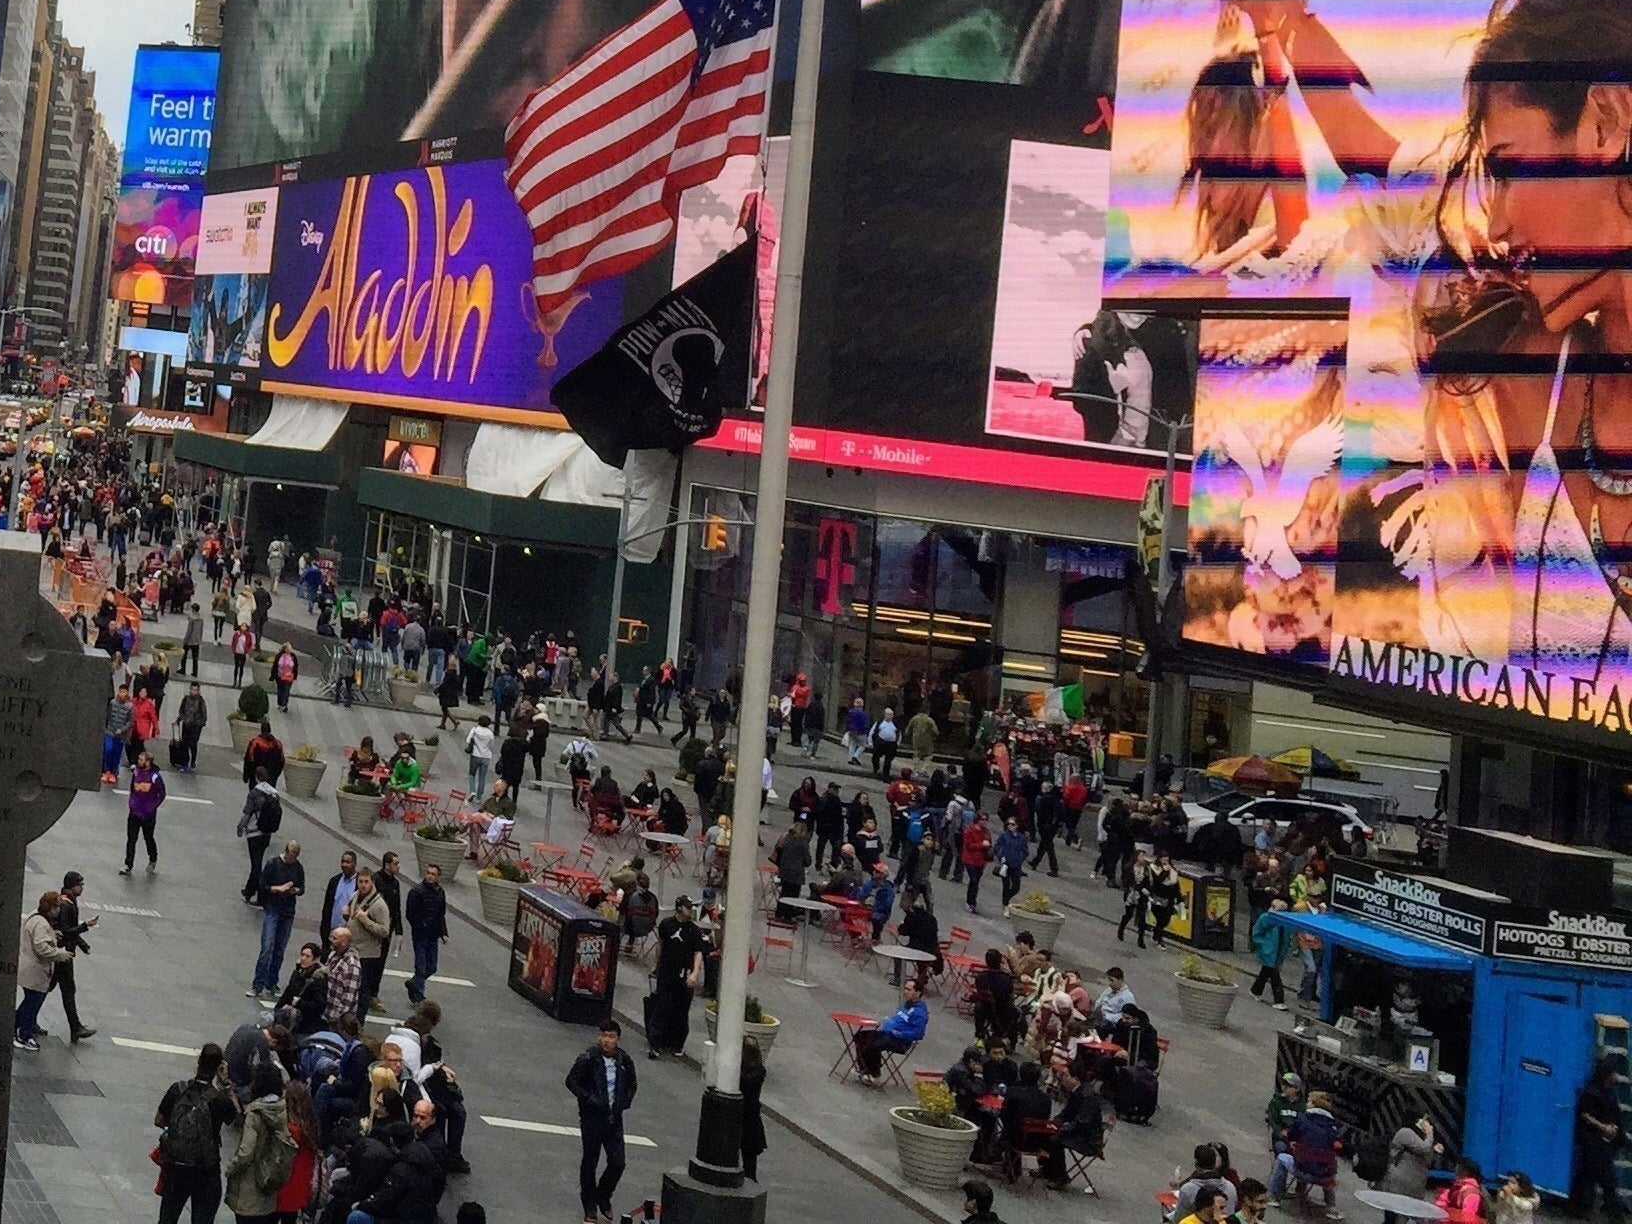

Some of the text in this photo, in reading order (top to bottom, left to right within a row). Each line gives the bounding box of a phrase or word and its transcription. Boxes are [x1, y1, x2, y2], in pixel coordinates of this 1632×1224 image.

[150, 94, 195, 120] Feel
[135, 235, 168, 255] citi
[269, 165, 494, 384] Aladdin
[1328, 636, 1556, 717] AMERICAN
[1374, 870, 1442, 908] SnackBox
[1336, 880, 1482, 936] HOTDOGS LOBSTER ROLLS
[1363, 902, 1450, 938] PRETZELS DOUGHNUTS
[1548, 909, 1627, 937] SnackBox
[1499, 928, 1631, 956] HOTDOGS LOBSTER
[1534, 946, 1577, 960] PRETZELS
[1414, 1050, 1425, 1064] A
